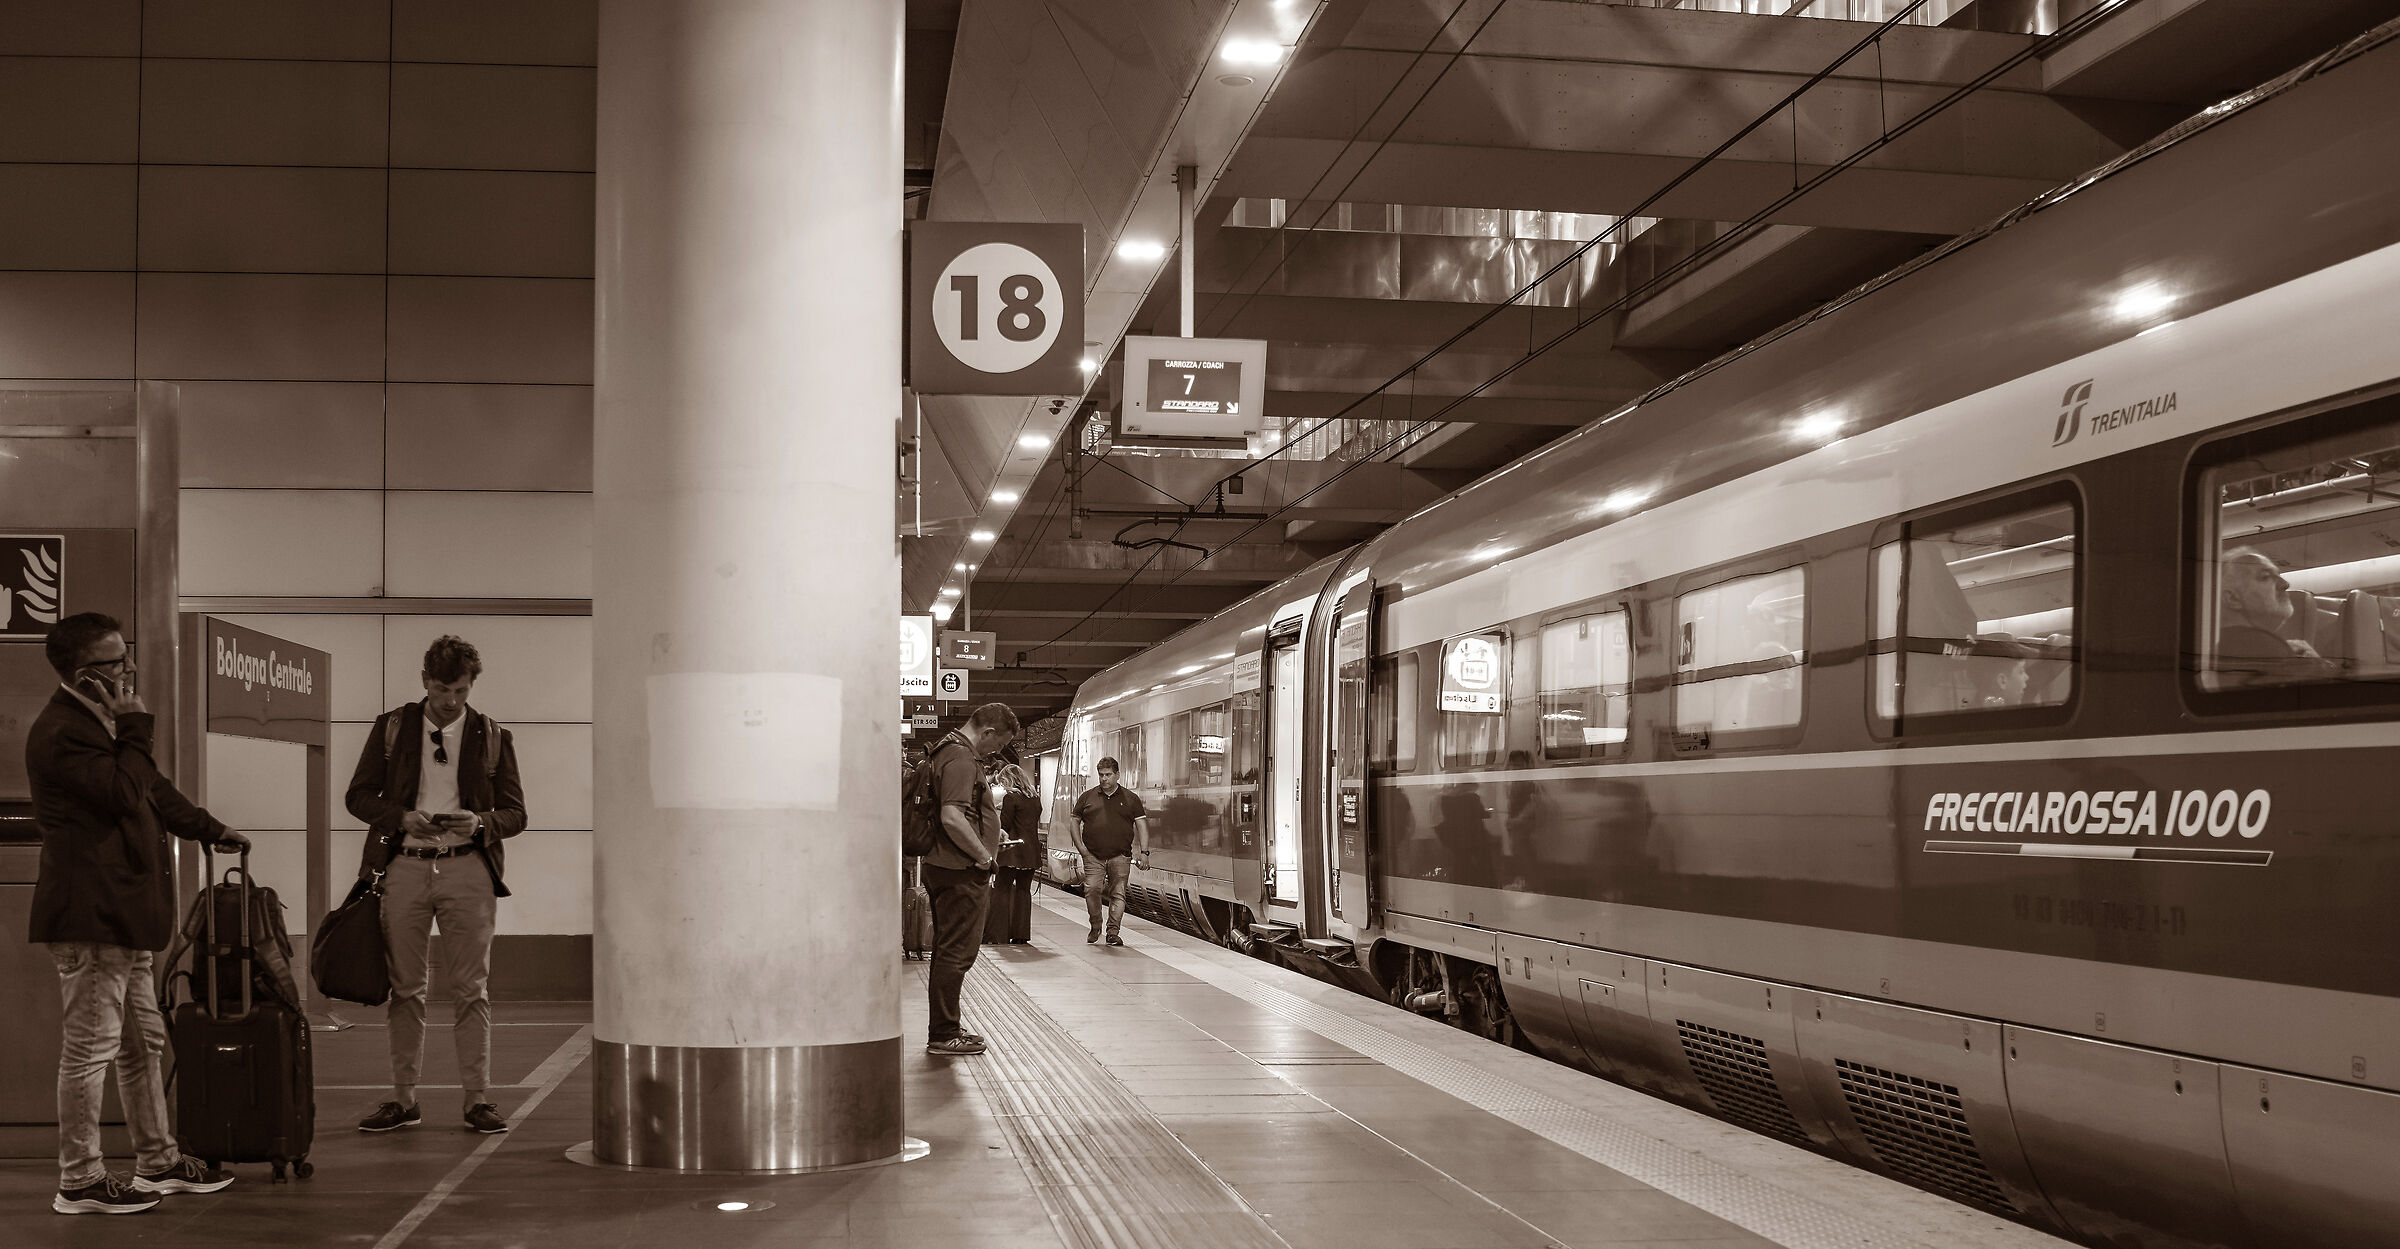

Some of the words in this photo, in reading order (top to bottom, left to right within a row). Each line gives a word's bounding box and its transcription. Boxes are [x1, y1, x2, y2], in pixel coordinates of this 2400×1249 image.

[950, 274, 1046, 342] 18
[1165, 360, 1198, 369] CARROZZA
[1202, 361, 1224, 370] COACH
[1183, 374, 1195, 395] 7
[1163, 400, 1220, 408] STANDARD
[2090, 392, 2177, 436] TRENITALIA
[963, 644, 970, 653] 8
[216, 636, 267, 692] Bologna
[269, 650, 312, 695] Centrale
[1924, 790, 2158, 836] FRECCIAROSSA
[2163, 788, 2272, 839] 1000
